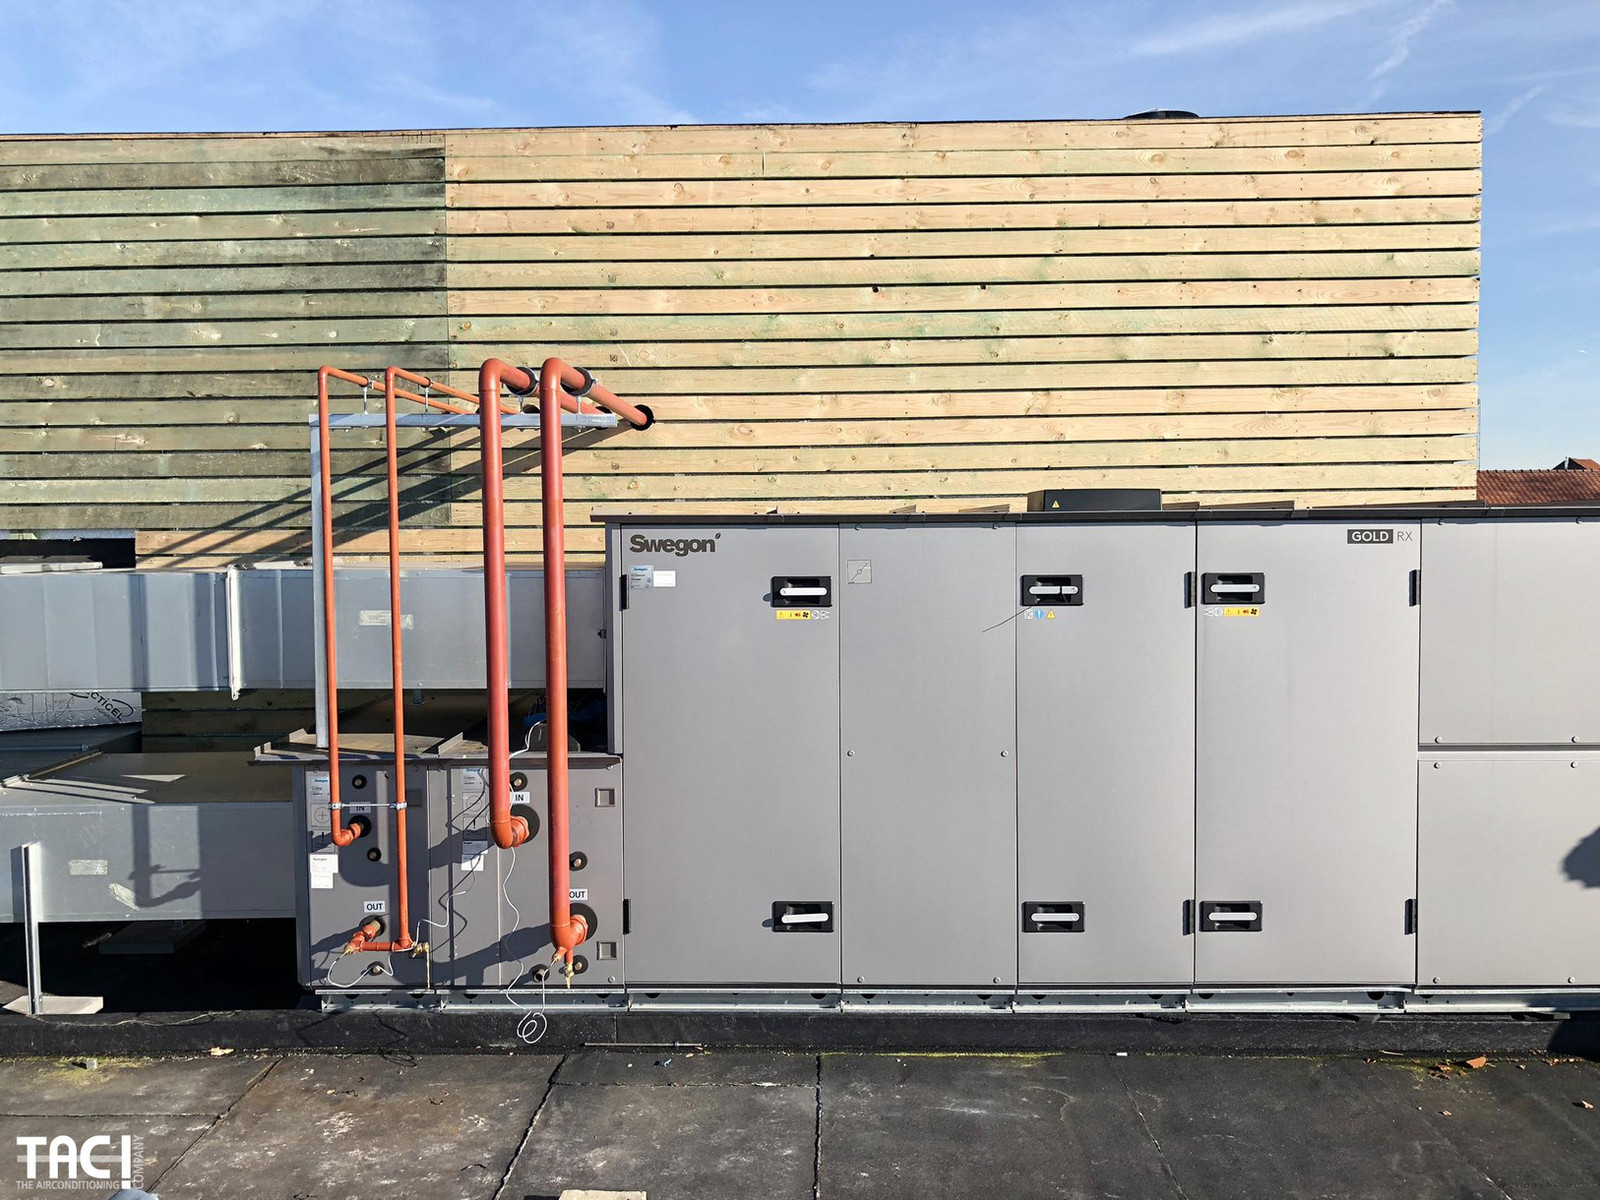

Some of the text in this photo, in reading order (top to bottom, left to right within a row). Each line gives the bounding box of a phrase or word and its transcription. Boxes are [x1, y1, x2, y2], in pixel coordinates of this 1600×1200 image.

[1352, 531, 1413, 542] GOLD RX
[629, 533, 716, 557] Swegon
[515, 794, 524, 802] IN
[569, 890, 585, 899] OUT
[366, 903, 383, 911] OUT
